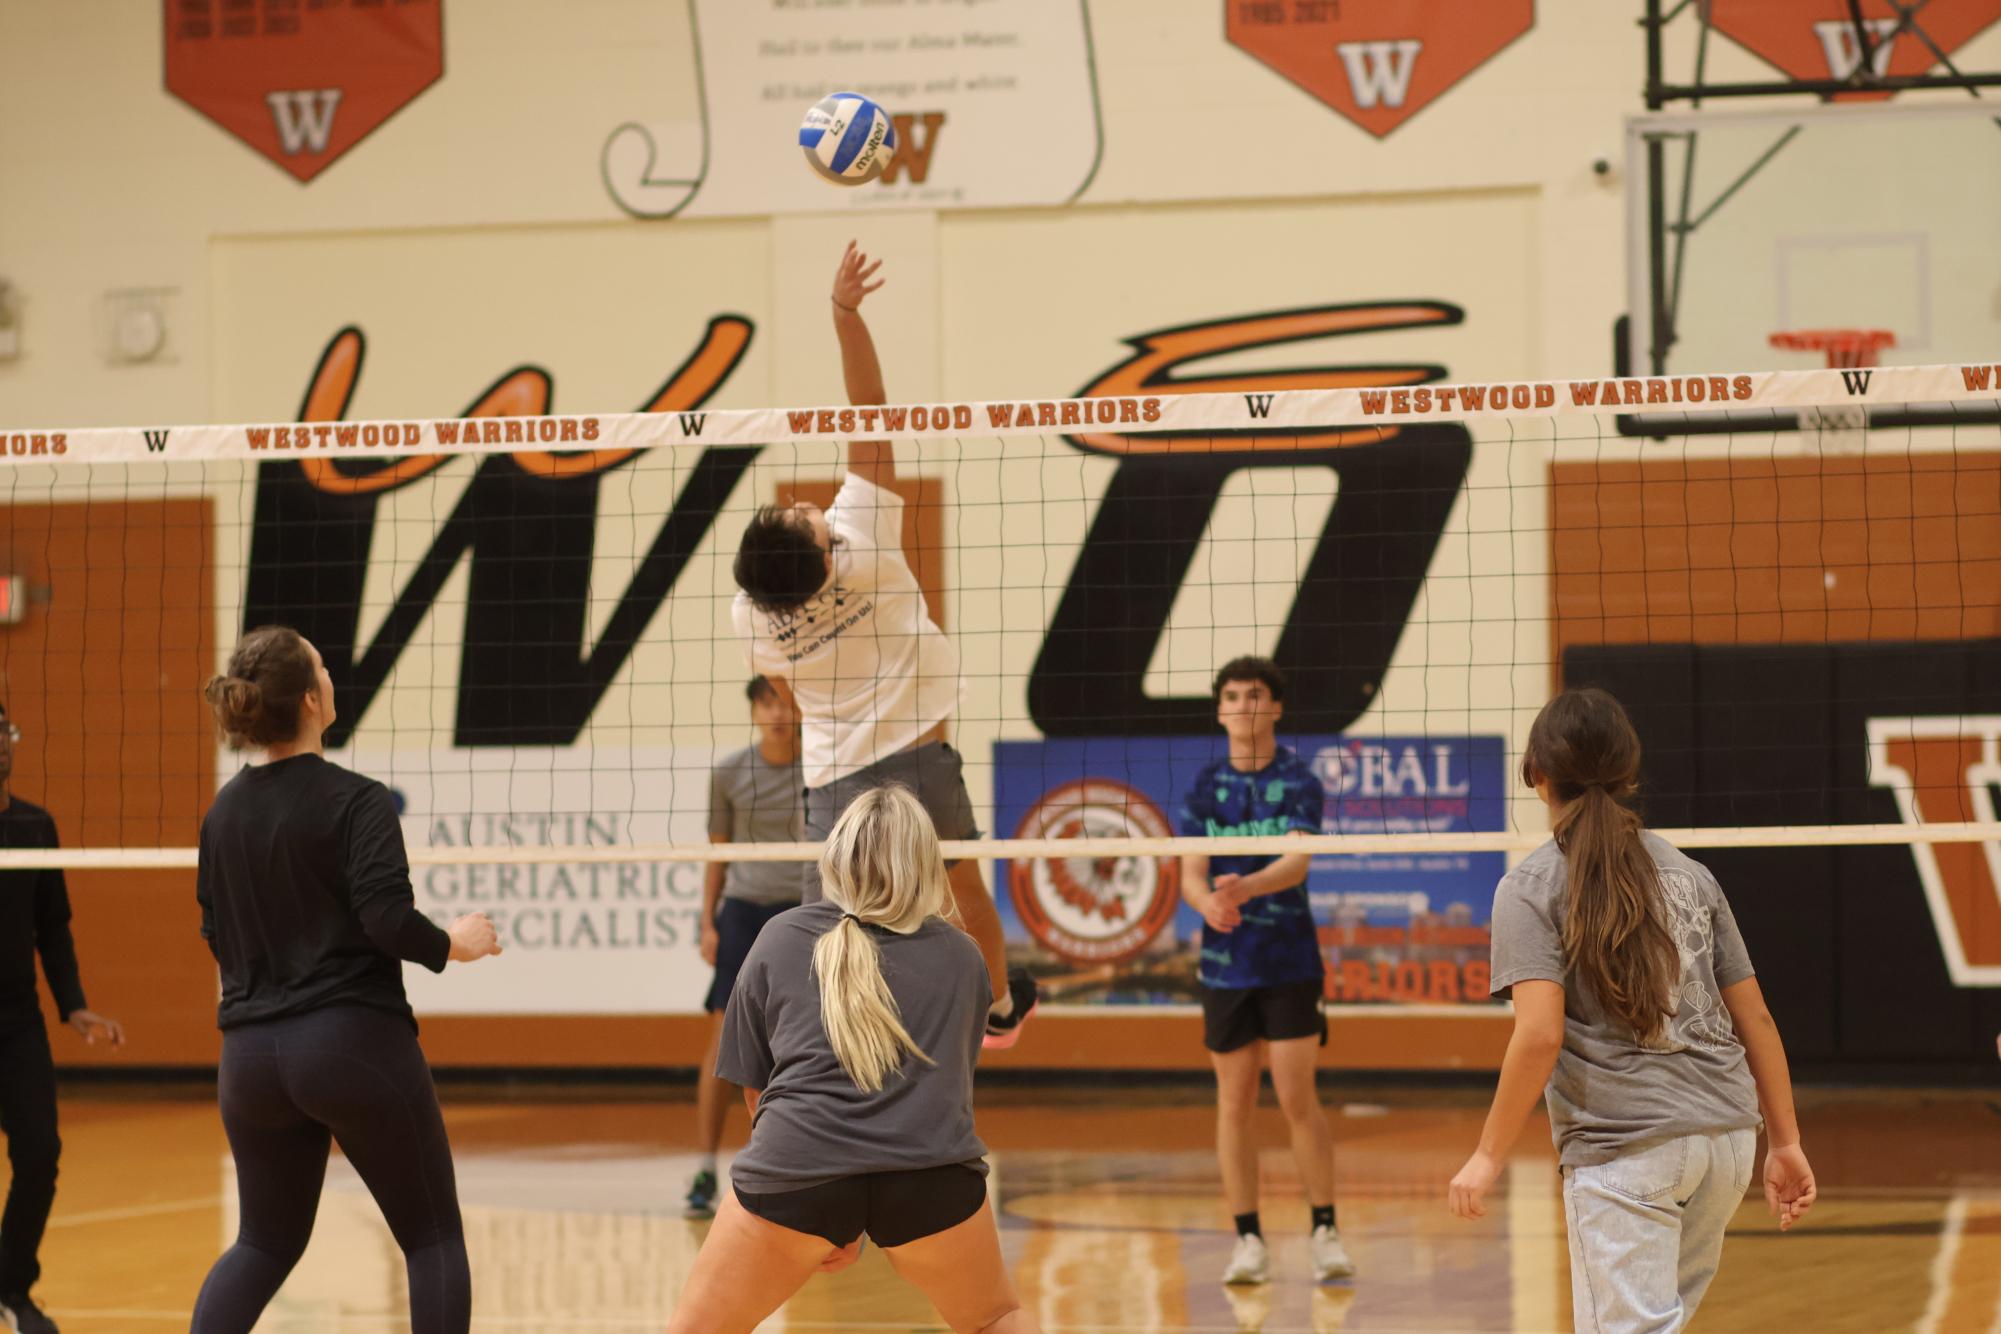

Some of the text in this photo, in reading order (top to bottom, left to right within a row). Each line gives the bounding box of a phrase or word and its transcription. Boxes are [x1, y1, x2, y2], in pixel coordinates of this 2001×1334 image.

[1336, 40, 1424, 109] W
[266, 88, 344, 154] W
[856, 122, 885, 170] molten
[1359, 375, 1754, 416] WESTWOOD WARRIORS
[1840, 370, 1873, 396] W
[679, 412, 707, 437] W
[787, 397, 1162, 435] WESTWOOD WARRIORS
[1245, 394, 1275, 419] W
[143, 430, 170, 453] W
[246, 417, 601, 451] WESTWOOD WARRIORS
[803, 640, 820, 655] Can
[819, 624, 847, 644] Count
[1311, 745, 1470, 795] OBAL
[430, 813, 619, 847] AUSTIN
[425, 862, 700, 902] GERIATRIC
[428, 907, 703, 948] ECIALIST
[1325, 958, 1490, 1001] RIORS
